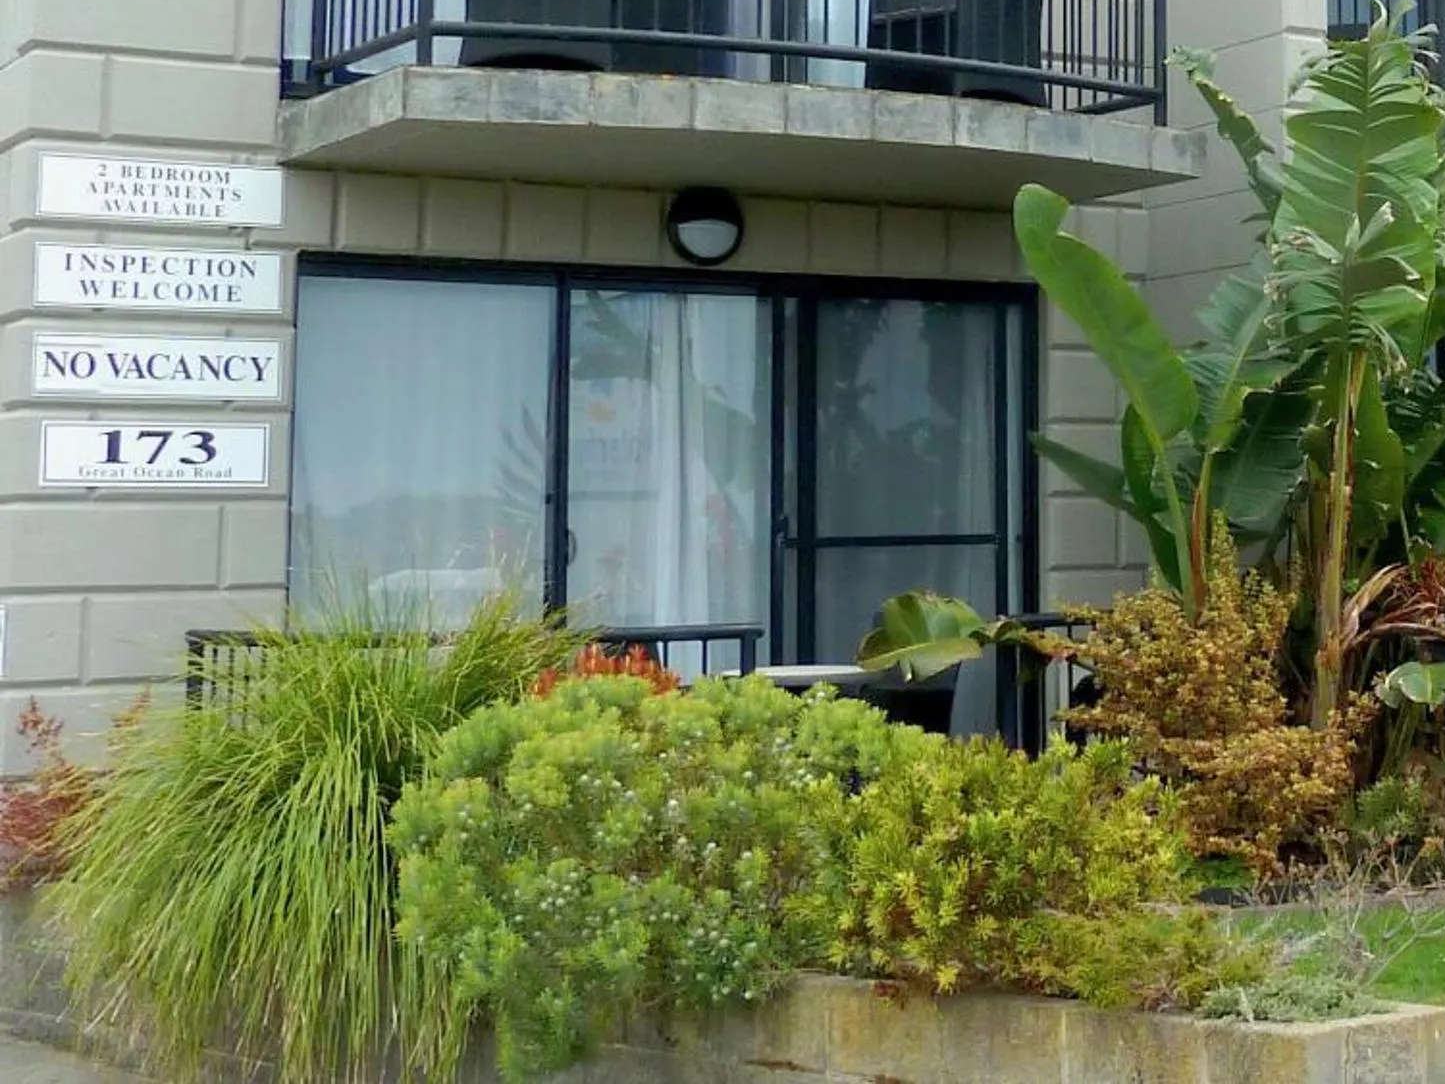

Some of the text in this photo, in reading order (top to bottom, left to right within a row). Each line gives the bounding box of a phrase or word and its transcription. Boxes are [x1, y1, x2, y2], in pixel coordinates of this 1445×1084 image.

[97, 164, 231, 185] 2 BEDROOM
[86, 181, 242, 202] APARTMENTS
[103, 200, 227, 218] AVAILABLE
[64, 252, 258, 278] INSPECTION
[79, 280, 242, 303] WELCOME
[43, 350, 273, 382] NO VACANCY
[98, 429, 218, 465] 173
[77, 466, 232, 480] Great Ocean Road
